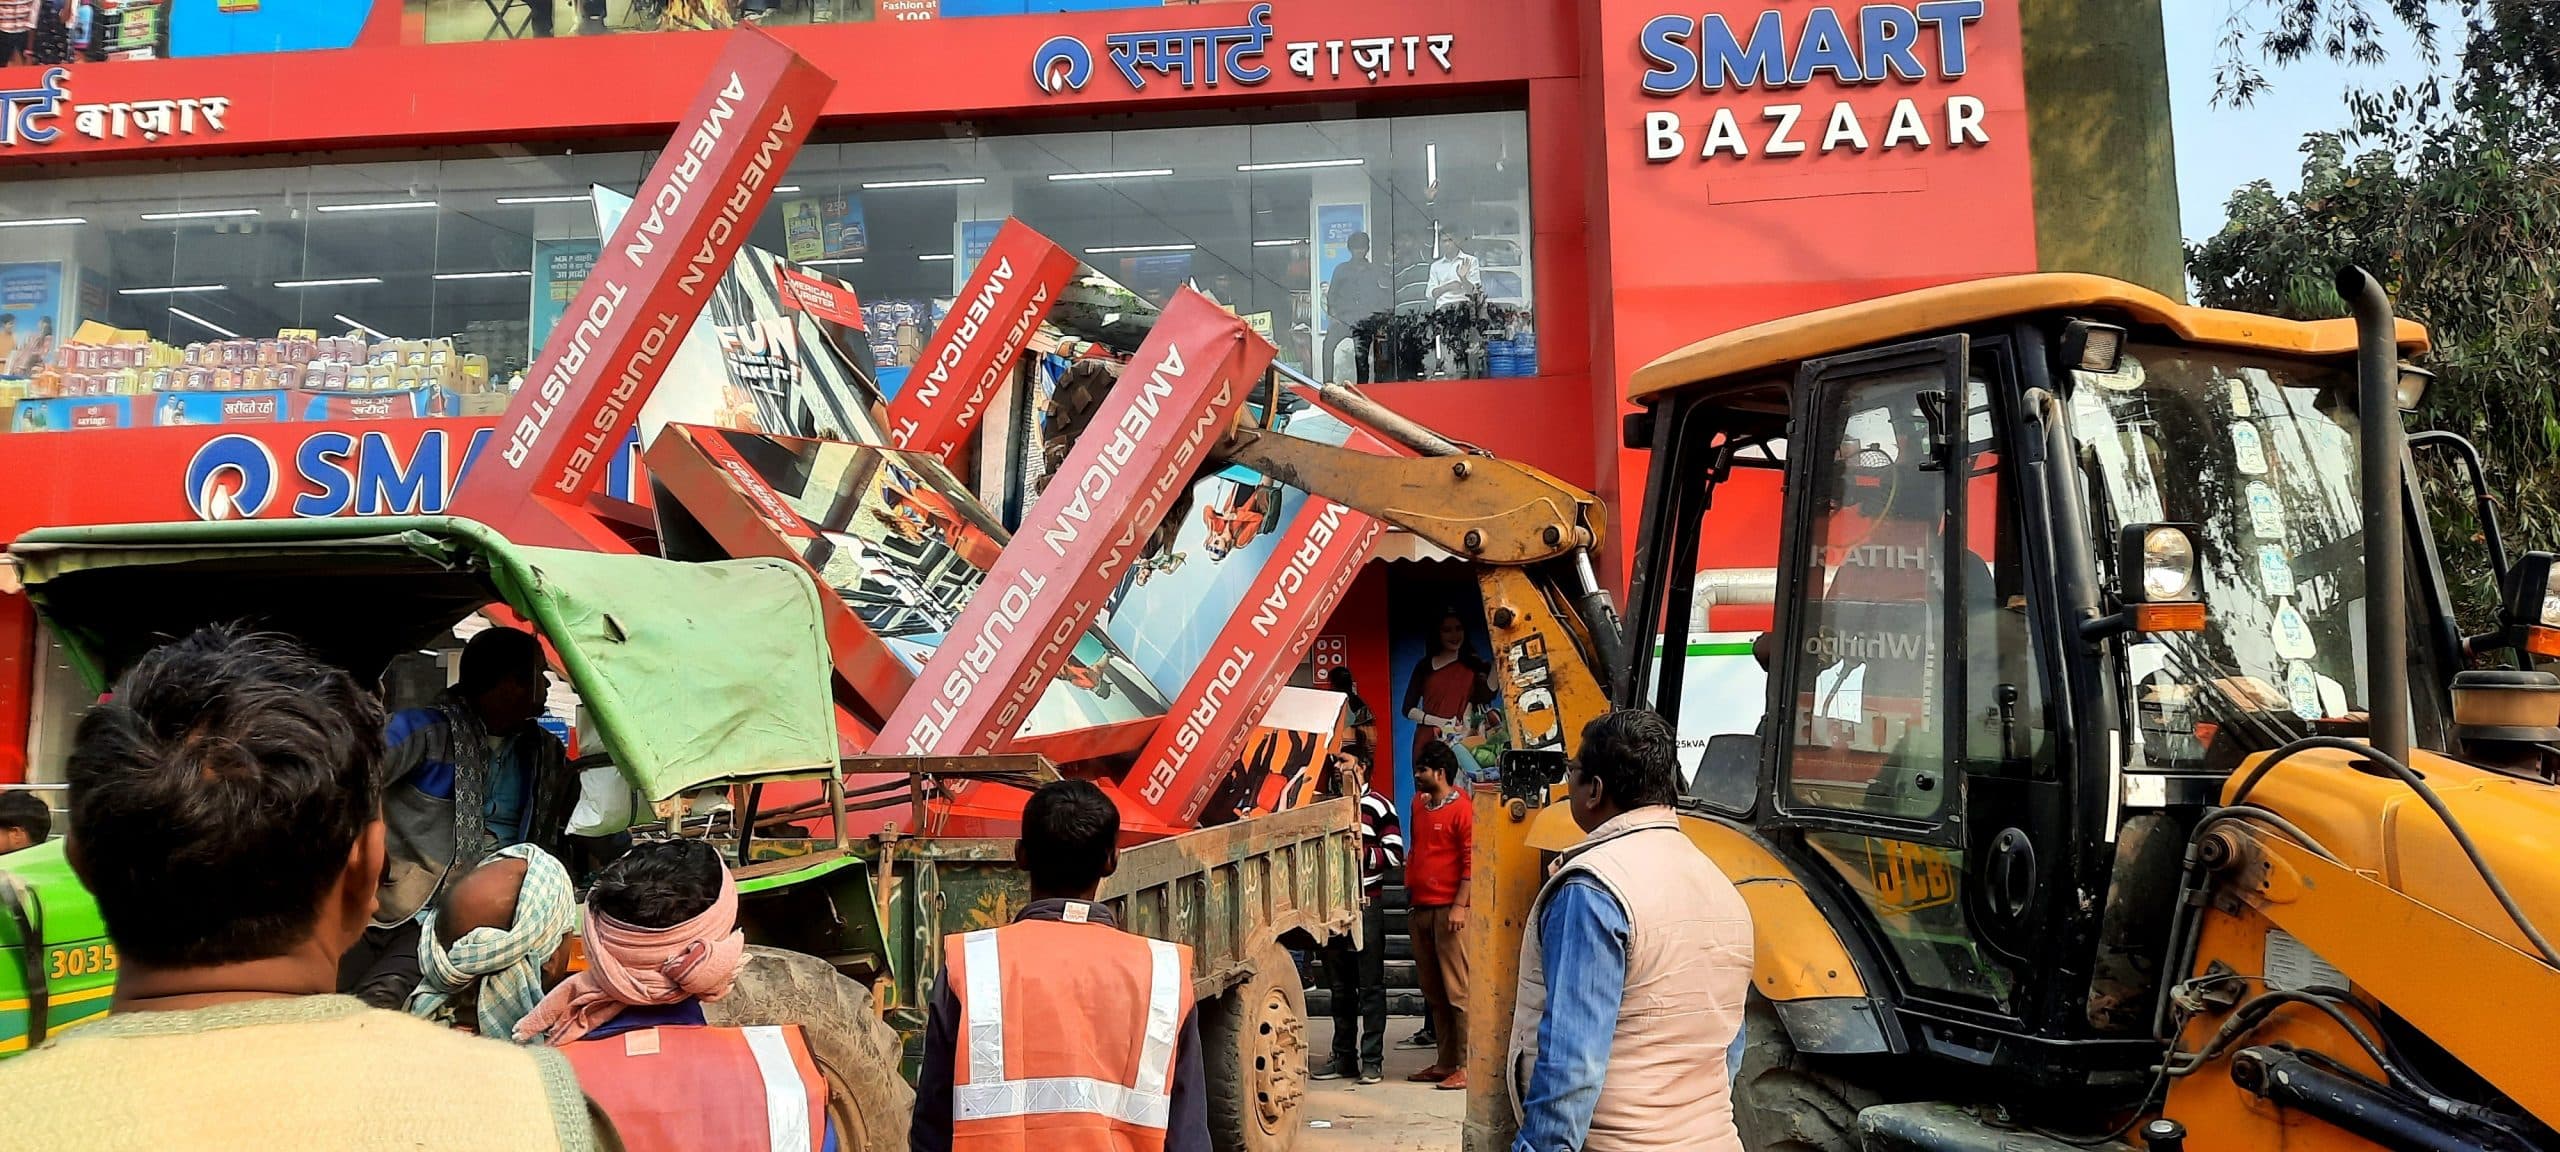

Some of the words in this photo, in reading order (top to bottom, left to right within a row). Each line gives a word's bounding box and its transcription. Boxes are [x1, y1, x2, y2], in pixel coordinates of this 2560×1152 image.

[882, 1, 925, 10] Fashion
[1106, 2, 1273, 90] स्मार्ट
[1287, 33, 1455, 82] बाज़ार
[1640, 0, 1985, 95] SMART
[74, 96, 231, 142] बाज़ार
[626, 71, 745, 268] AMERICAN
[1645, 95, 1990, 163] BAZAAR
[677, 105, 793, 297] AMERICAN
[714, 316, 801, 366] FUN
[783, 284, 836, 309] TURISTER
[916, 255, 1014, 408] AMERICAN
[955, 281, 1047, 429] AMERICAN
[224, 400, 255, 415] खरीदते
[257, 399, 274, 414] रहो
[502, 280, 626, 470] TOURISTER
[555, 310, 678, 493] TOURISTER
[728, 358, 772, 380] TAKE
[1042, 342, 1186, 558] AMERICAN
[1098, 379, 1234, 580] AMERICAN
[1250, 502, 1350, 639] MERICAN
[1292, 520, 1381, 656] MERICAN
[1139, 644, 1255, 808] TOURISTER
[1182, 670, 1288, 824] TOURISTER
[1508, 639, 1563, 752] JC
[1877, 838, 1949, 906] JCB
[50, 943, 120, 979] 3035
